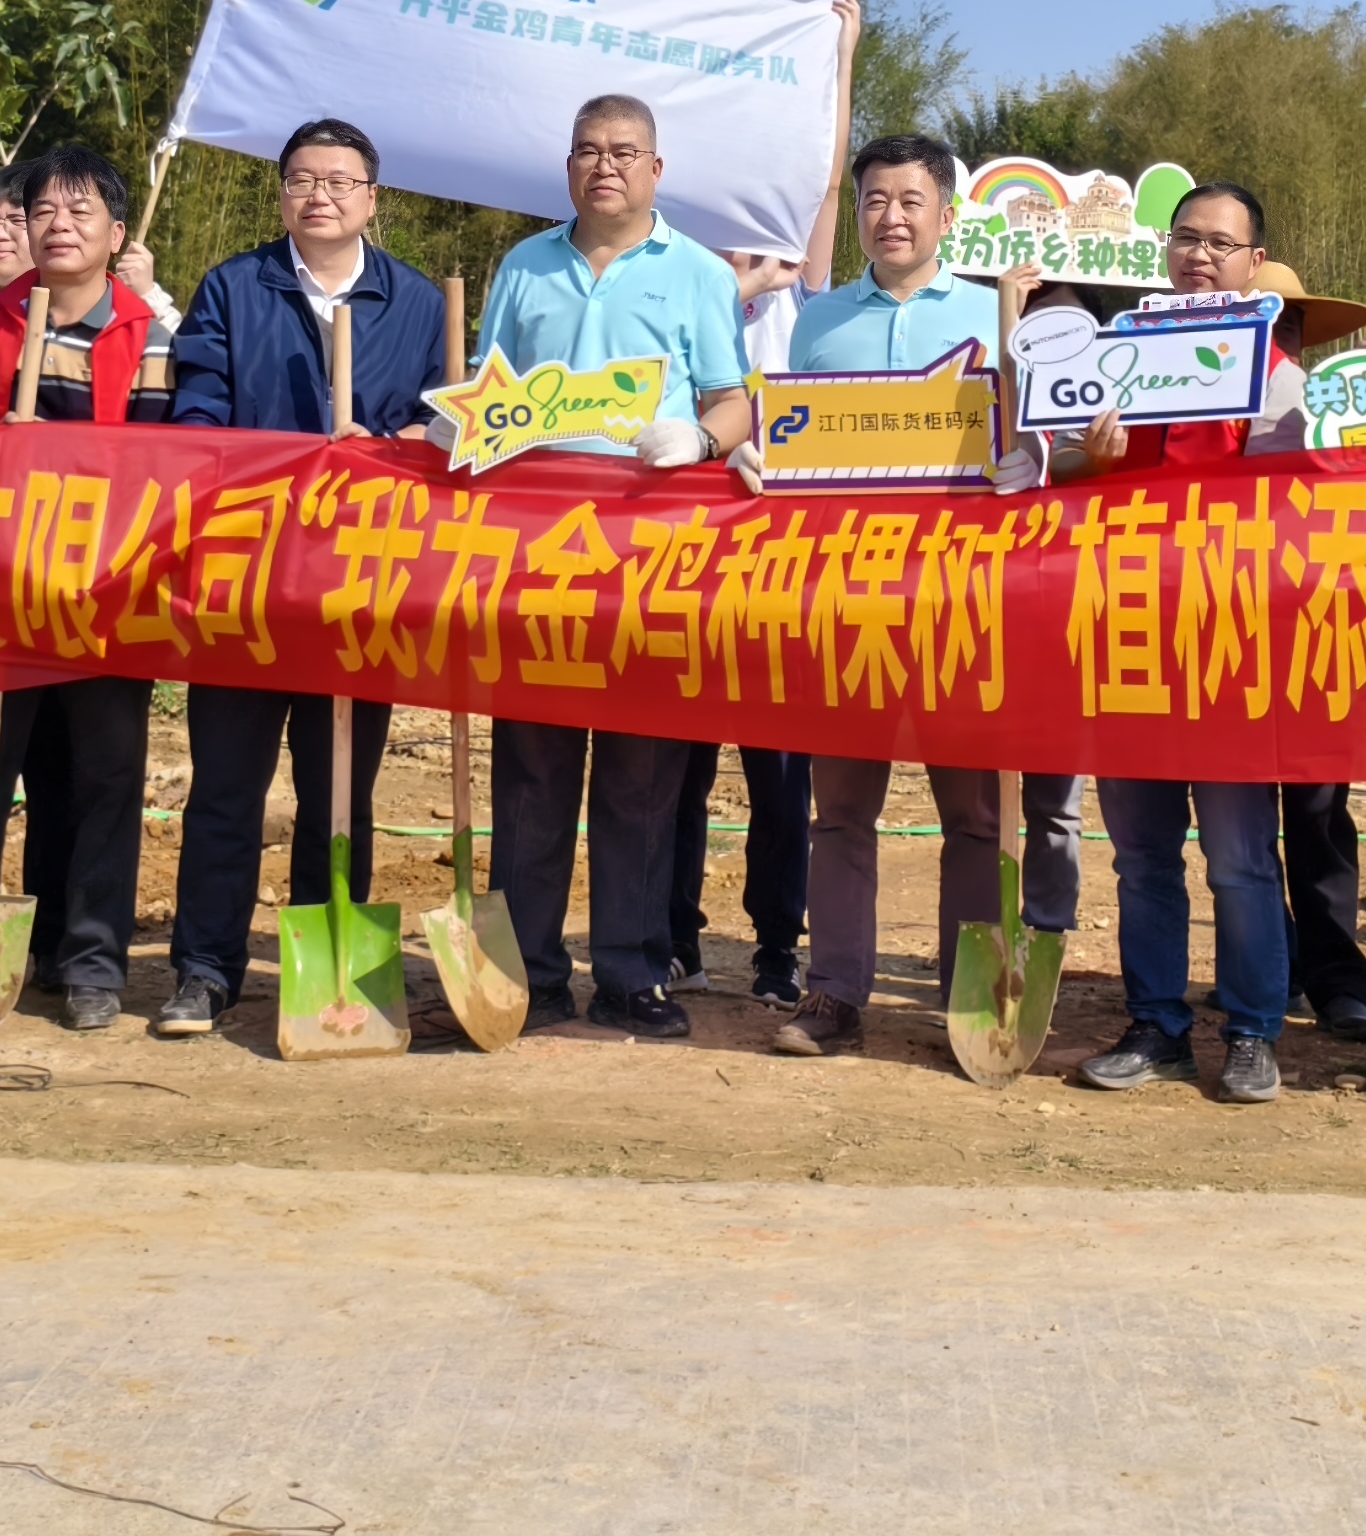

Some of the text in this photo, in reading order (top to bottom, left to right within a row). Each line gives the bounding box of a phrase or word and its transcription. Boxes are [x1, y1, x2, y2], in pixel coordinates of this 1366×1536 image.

[818, 410, 985, 433] 江门国际货柜码头
